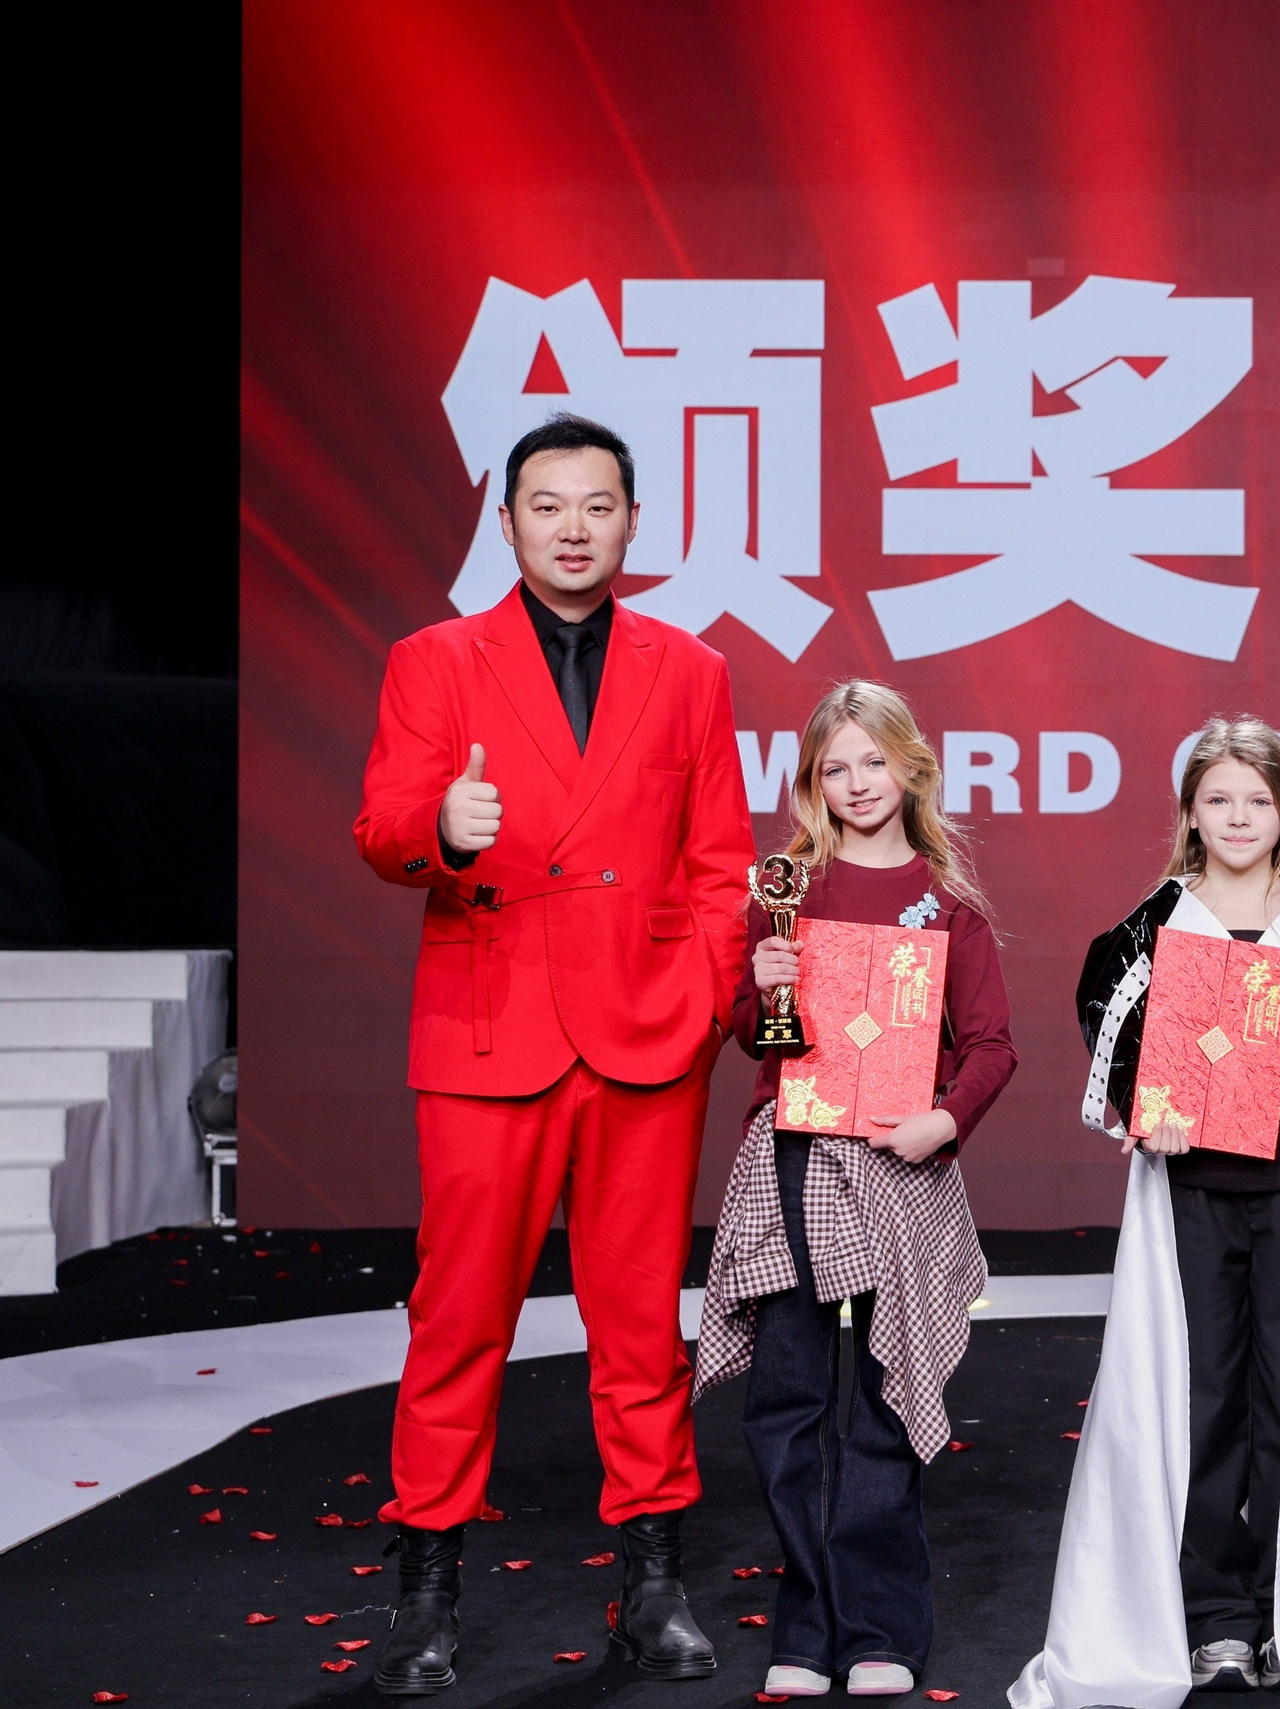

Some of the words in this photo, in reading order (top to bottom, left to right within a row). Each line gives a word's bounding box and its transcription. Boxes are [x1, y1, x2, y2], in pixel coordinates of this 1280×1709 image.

[762, 854, 796, 899] 3
[889, 942, 932, 1013] 荣誉证书
